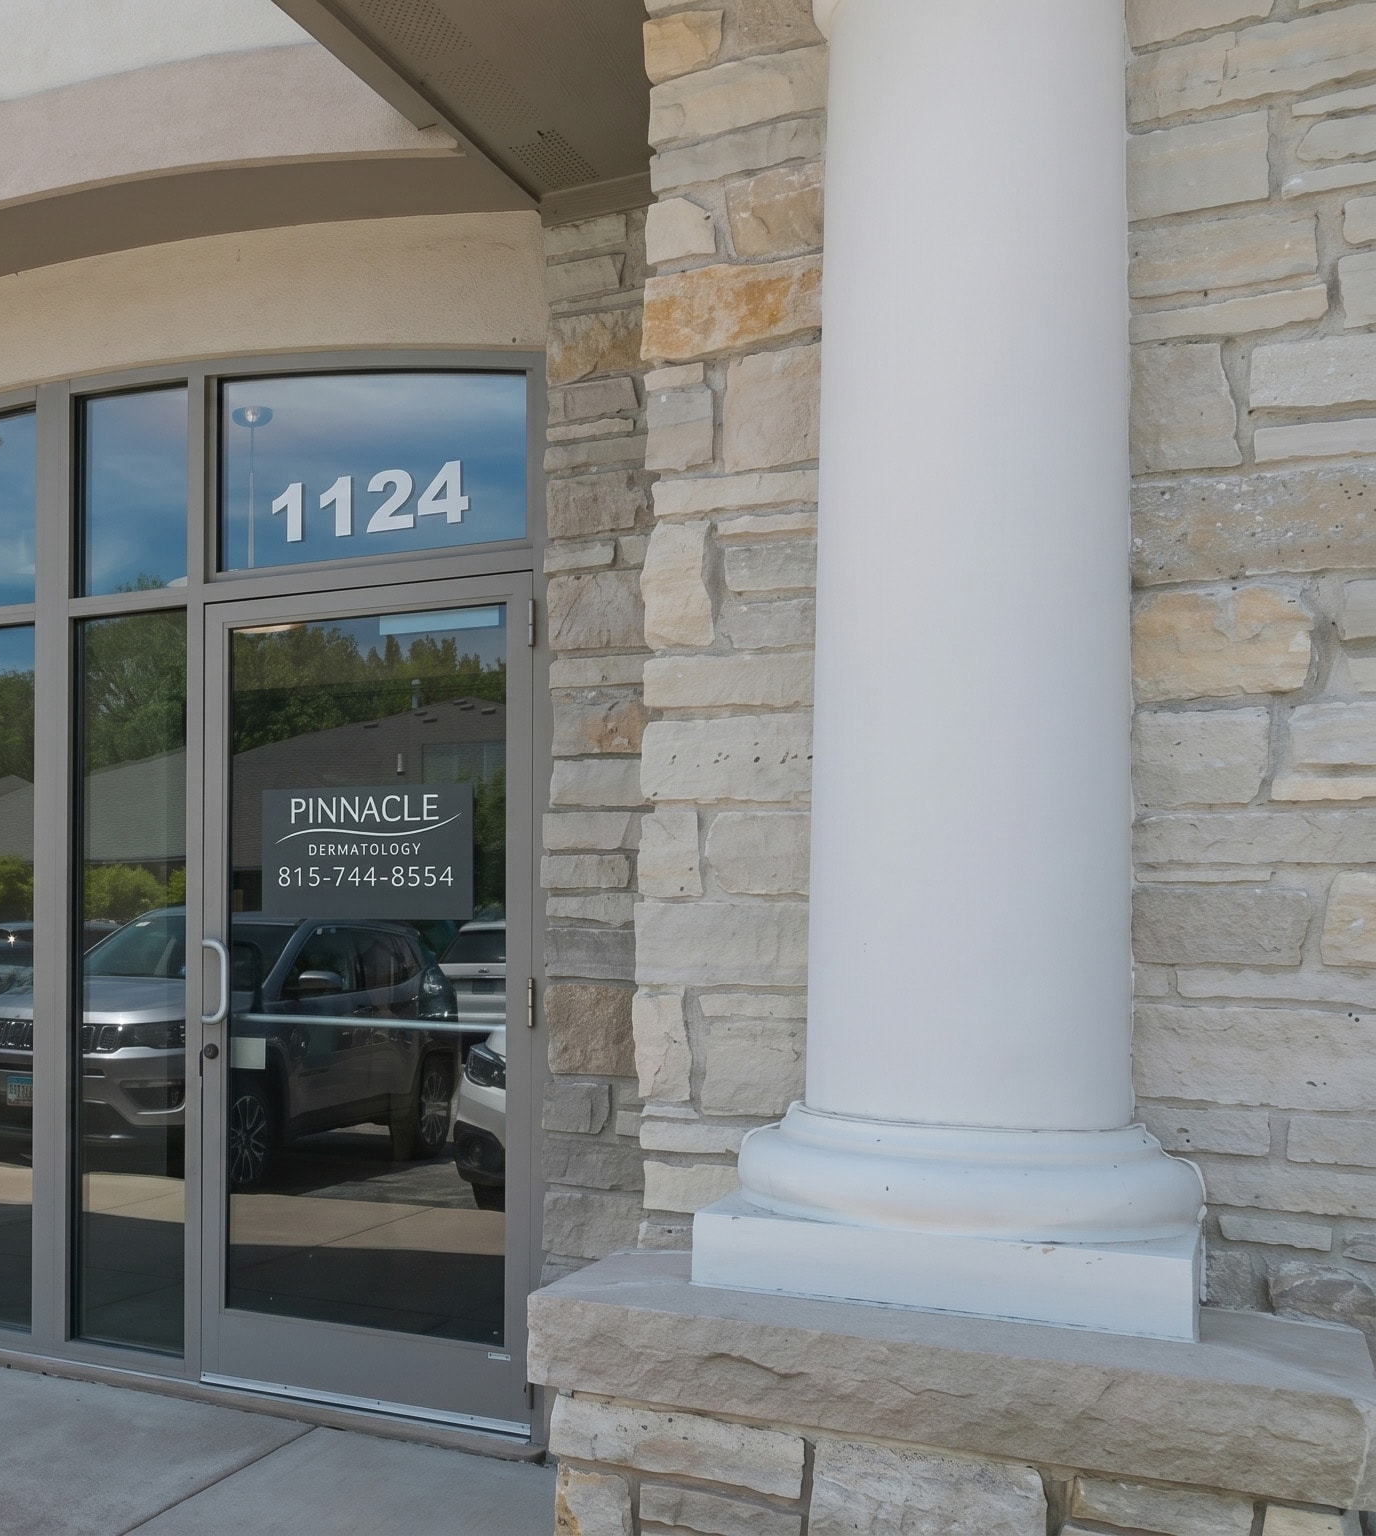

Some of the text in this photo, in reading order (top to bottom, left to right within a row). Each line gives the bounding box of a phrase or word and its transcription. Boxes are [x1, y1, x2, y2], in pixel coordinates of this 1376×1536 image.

[272, 460, 469, 542] 1124
[290, 794, 439, 824] PINNACLE
[308, 843, 421, 856] DERMATOLOGY
[278, 866, 454, 887] 815-744-8554
